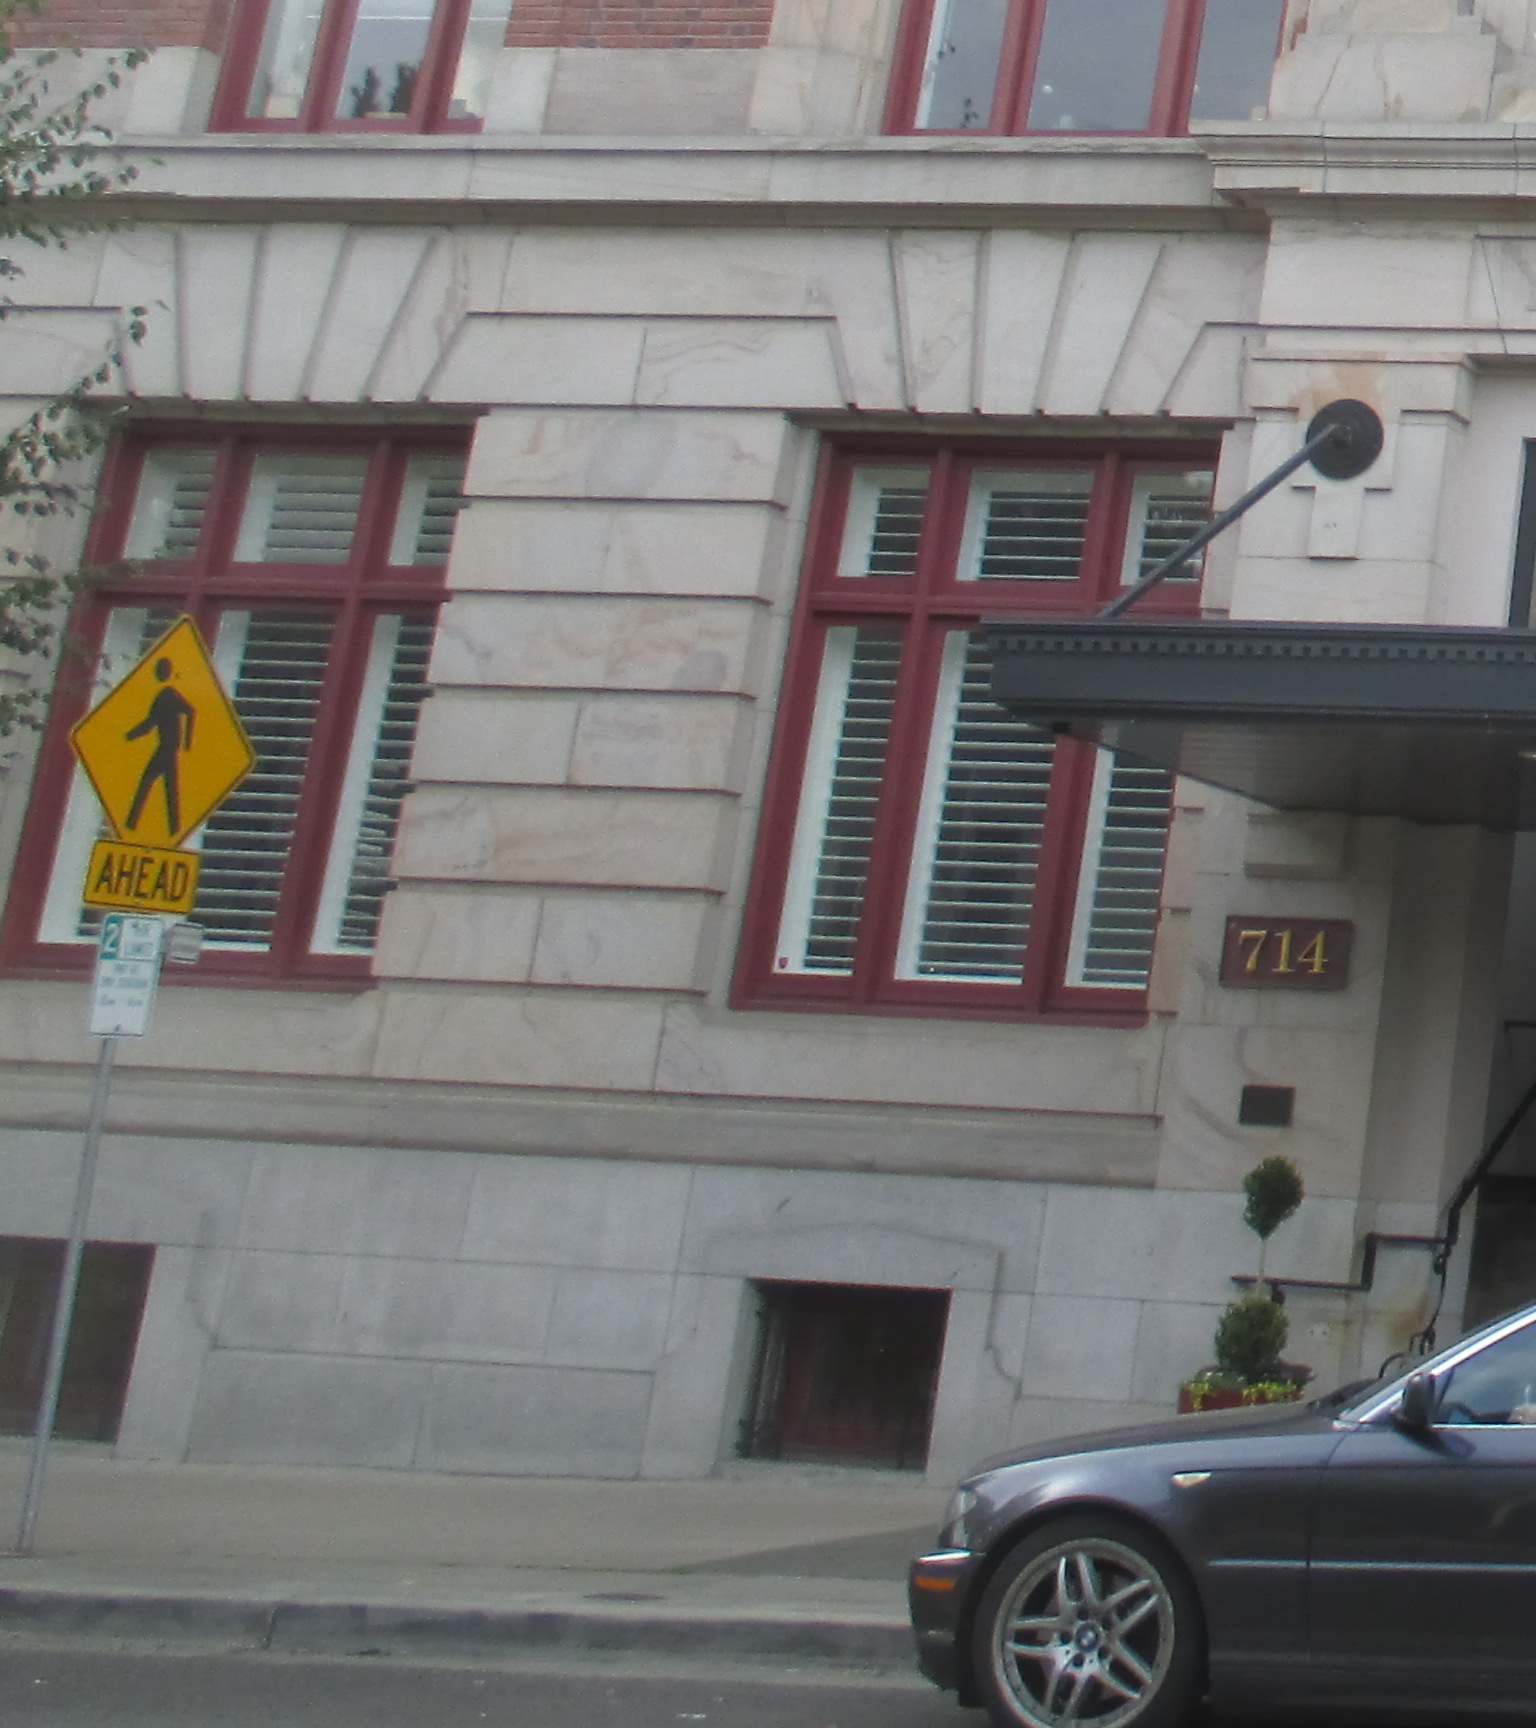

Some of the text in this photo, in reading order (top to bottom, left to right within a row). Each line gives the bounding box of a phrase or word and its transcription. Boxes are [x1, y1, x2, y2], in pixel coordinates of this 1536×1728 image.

[95, 853, 190, 902] AHEAD
[103, 923, 120, 952] 2
[1238, 929, 1329, 973] 714
